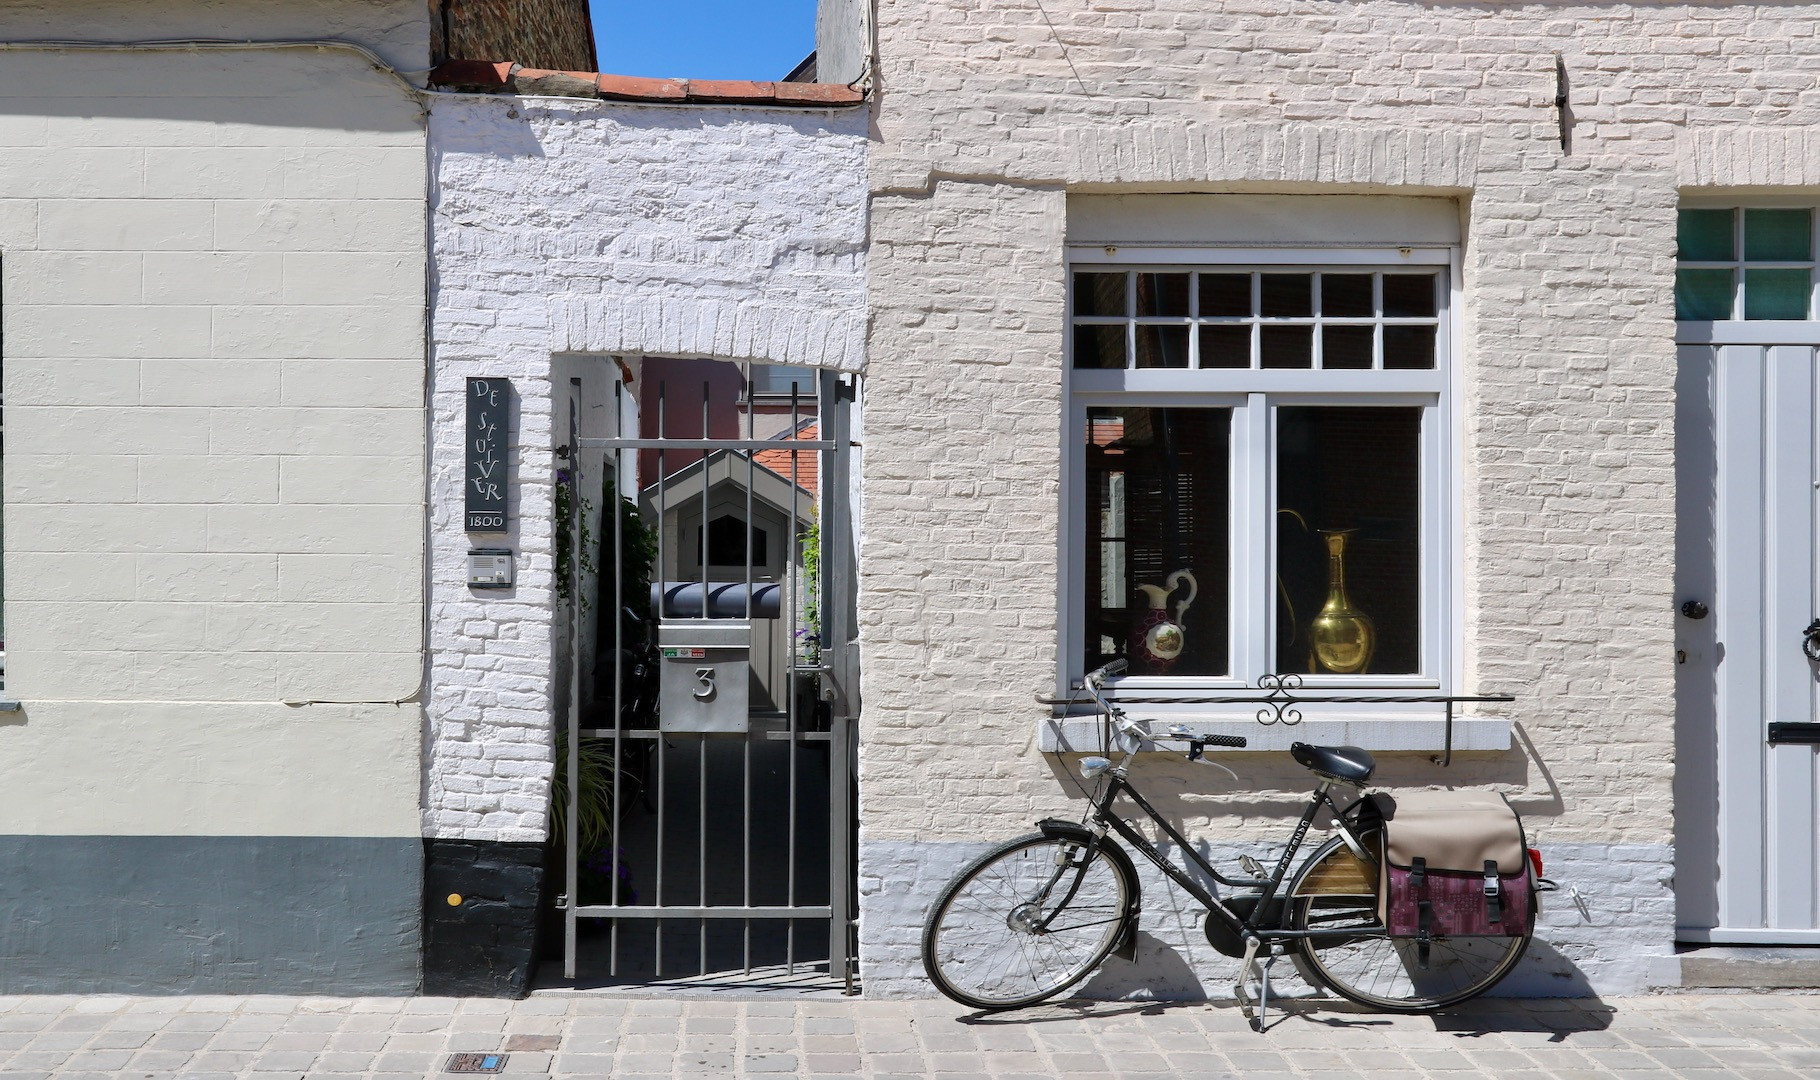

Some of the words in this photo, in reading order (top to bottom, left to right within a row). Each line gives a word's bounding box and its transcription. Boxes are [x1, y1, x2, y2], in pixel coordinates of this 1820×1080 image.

[471, 380, 499, 407] DE
[469, 516, 503, 527] 1800
[692, 667, 714, 697] 3
